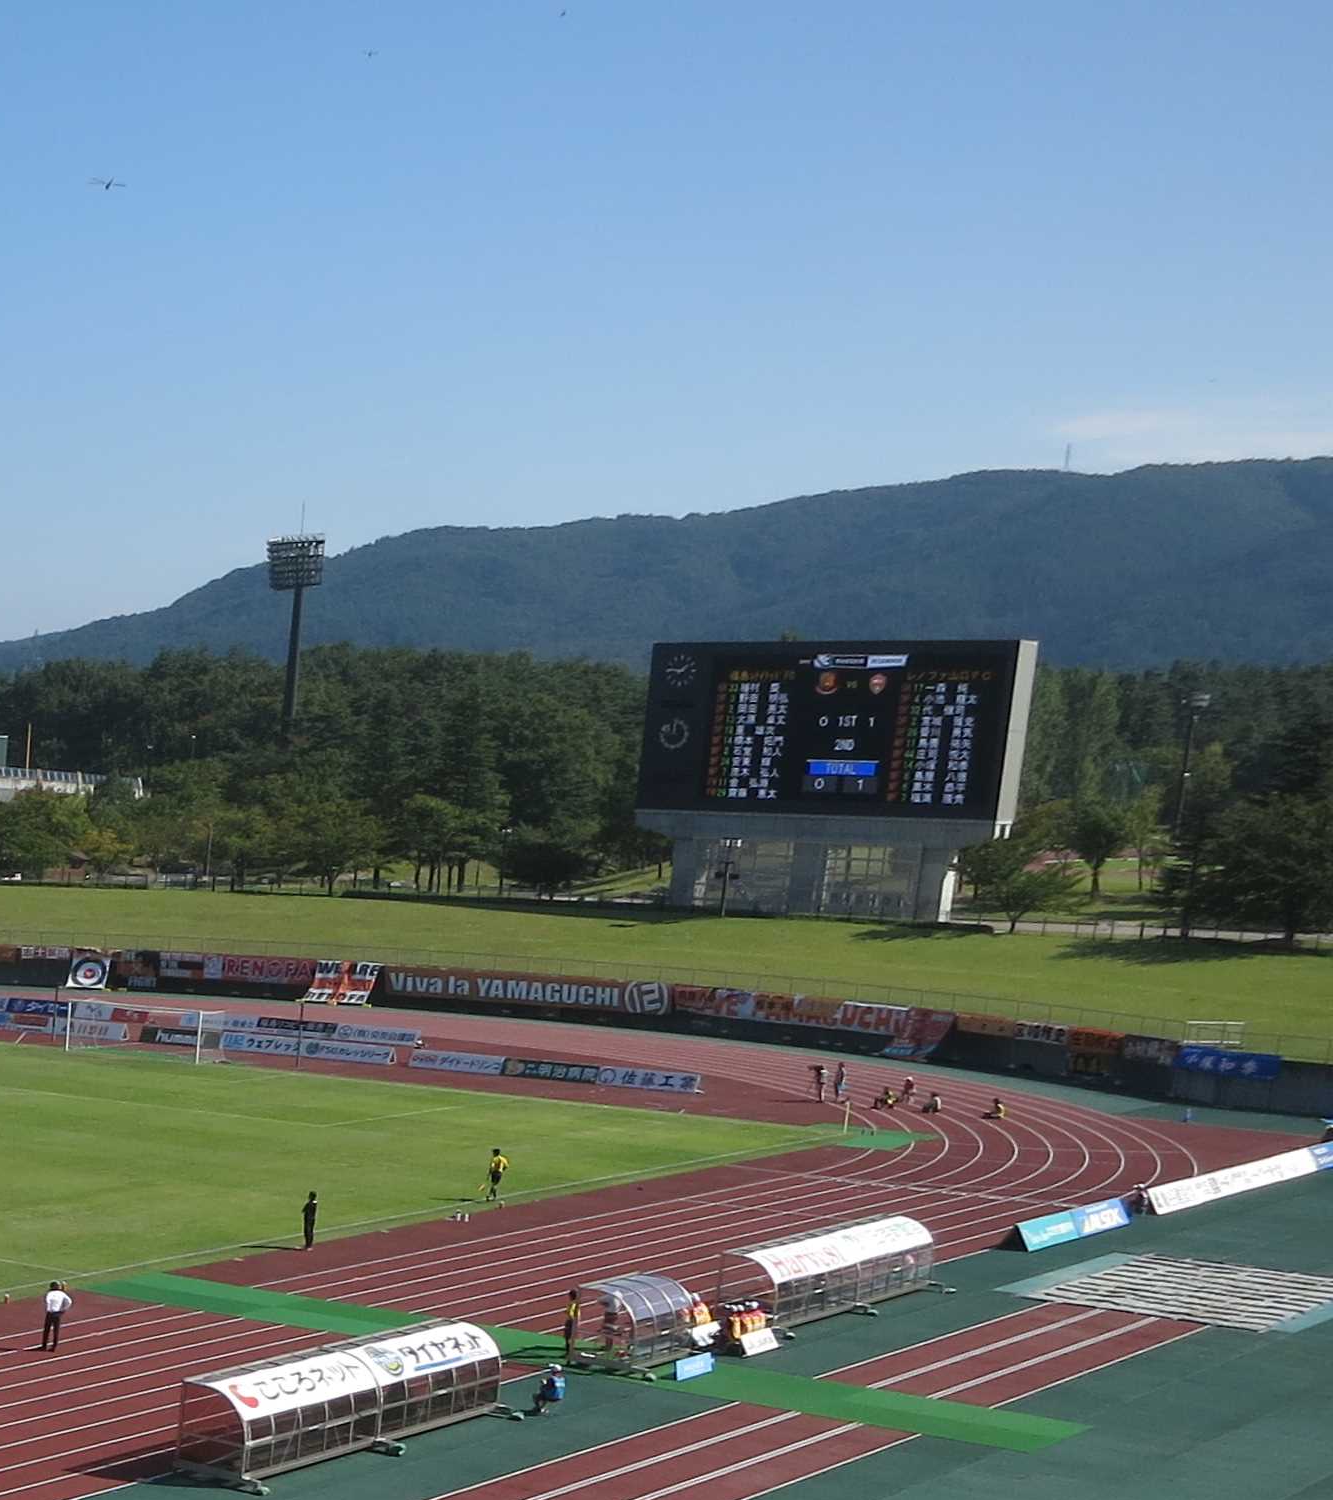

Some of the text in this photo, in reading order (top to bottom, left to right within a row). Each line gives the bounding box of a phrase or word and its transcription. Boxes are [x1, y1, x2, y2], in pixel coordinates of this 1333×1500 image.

[819, 715, 875, 727] 0 1ST 1
[825, 763, 857, 775] TOTAL
[814, 778, 864, 790] 0 1
[224, 958, 313, 980] RENOFA
[389, 971, 620, 1008] Viva la YAMAGUCHI
[621, 1069, 696, 1091] 佐藤工業
[252, 1358, 361, 1400] こころネット
